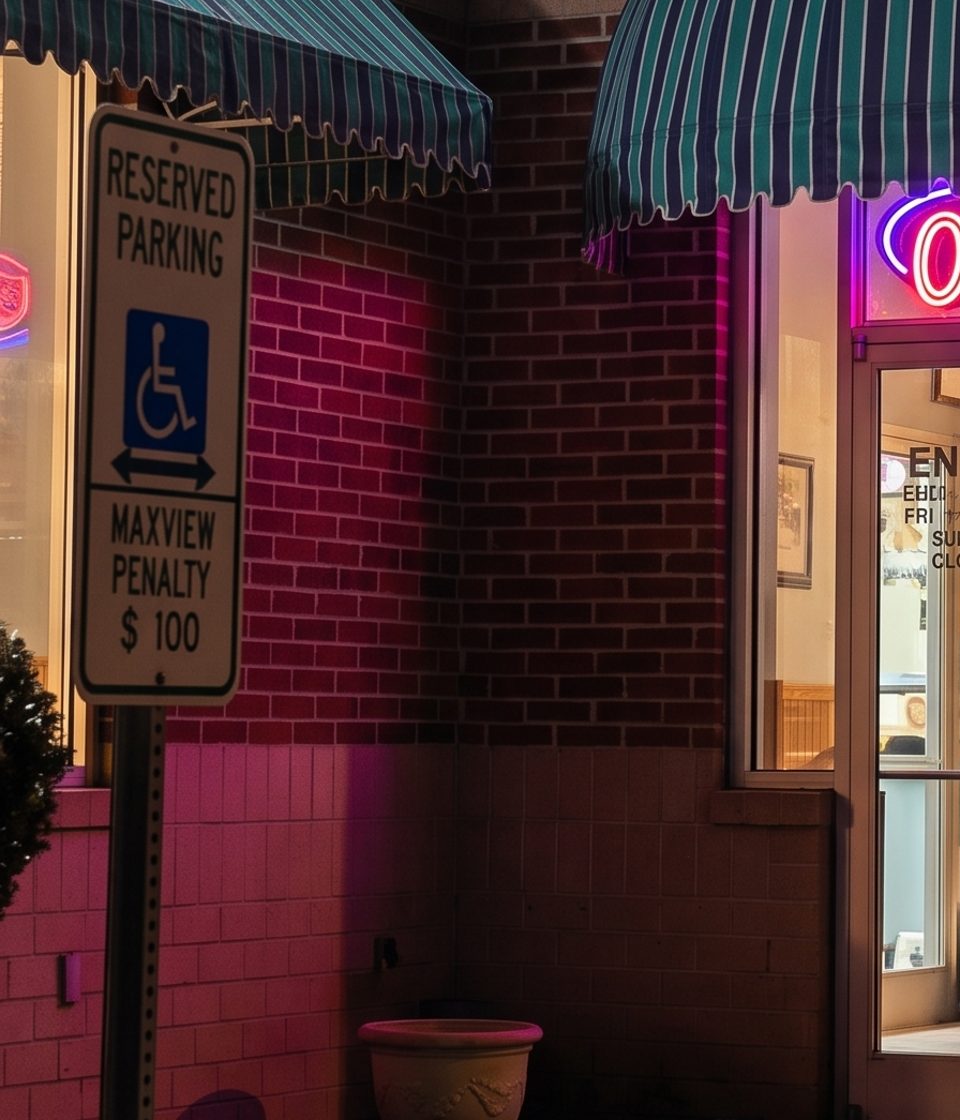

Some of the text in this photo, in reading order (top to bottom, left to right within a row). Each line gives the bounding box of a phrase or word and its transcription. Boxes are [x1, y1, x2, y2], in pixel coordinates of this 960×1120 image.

[107, 147, 236, 220] RESERVED
[117, 212, 223, 278] PARKING
[111, 502, 216, 551] MAXVIEW
[904, 507, 934, 524] FRI
[111, 553, 212, 600] PENALTY
[120, 605, 200, 654] $ 100
